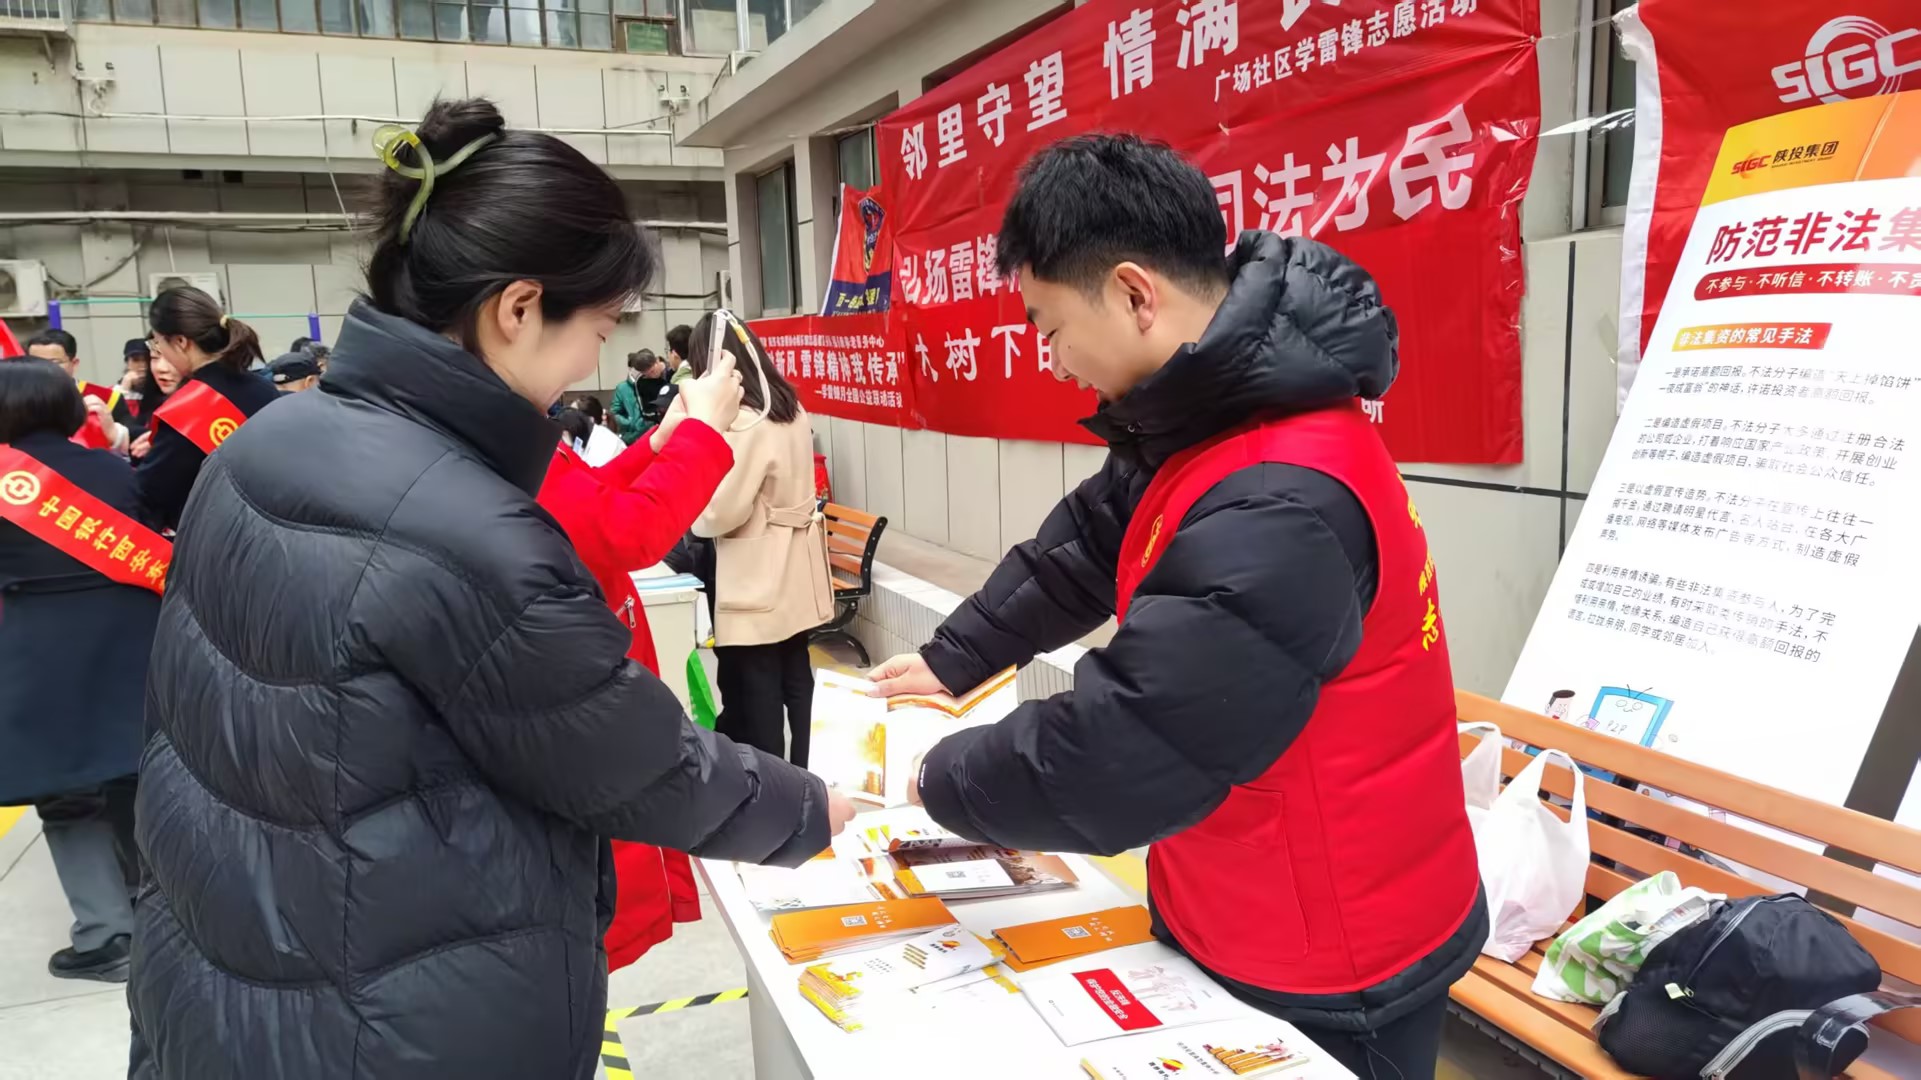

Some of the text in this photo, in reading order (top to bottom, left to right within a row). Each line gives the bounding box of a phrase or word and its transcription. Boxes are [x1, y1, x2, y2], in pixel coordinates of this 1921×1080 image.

[1771, 28, 1921, 104] SIGC
[900, 52, 1068, 180] 邻里守望
[1731, 154, 1772, 175] SIGC
[1773, 141, 1839, 164] 陕投集团
[900, 233, 1021, 305] 弘扬雷锋
[1680, 327, 1813, 347] 非法集资的常见手法
